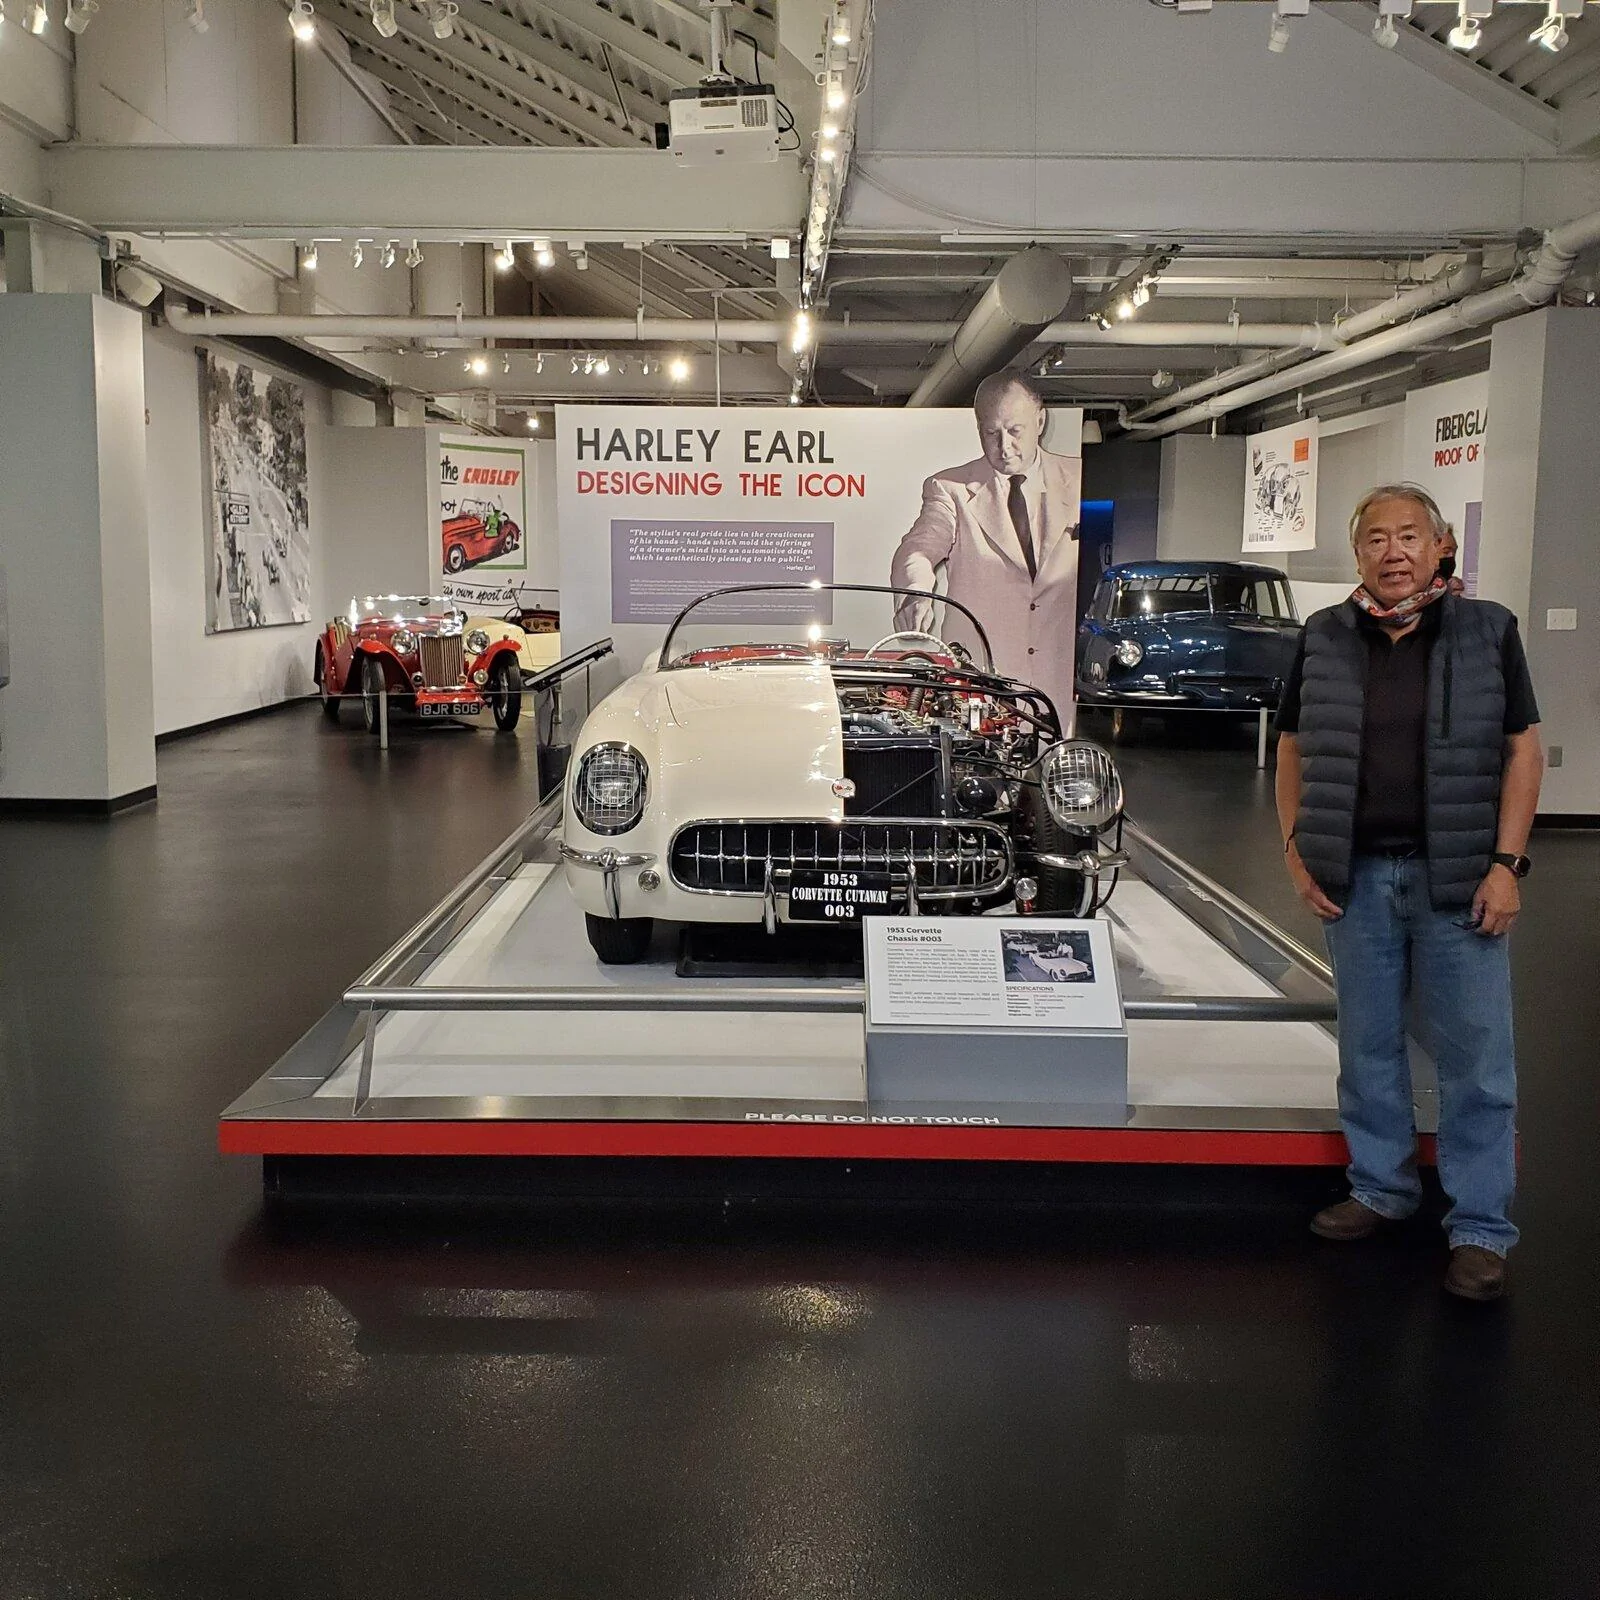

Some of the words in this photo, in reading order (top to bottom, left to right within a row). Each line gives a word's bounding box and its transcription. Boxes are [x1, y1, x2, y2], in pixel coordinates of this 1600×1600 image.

[576, 427, 721, 462] HARLEY
[743, 430, 835, 464] EARL
[1434, 446, 1463, 468] PROOF
[1466, 443, 1480, 462] OF
[440, 455, 459, 481] the
[462, 467, 520, 486] CROSLEY
[576, 471, 723, 496] DESIGNING
[738, 473, 783, 497] THE
[798, 473, 866, 497] ICON
[649, 529, 681, 538] stylist's
[700, 530, 723, 539] pride
[629, 538, 639, 547] of
[686, 538, 711, 546] hands
[775, 539, 812, 548] offerings
[629, 546, 639, 554] of
[646, 546, 686, 554] dreamer's
[741, 547, 786, 555] automotive
[787, 548, 814, 556] design
[664, 554, 717, 563] aesthetically
[717, 555, 752, 563] pleasing
[455, 587, 474, 599] own
[475, 588, 502, 606] sport
[423, 704, 449, 715] BJR
[452, 703, 479, 715] 606
[823, 873, 858, 886] 1953
[791, 887, 843, 902] CORVETTE
[845, 889, 888, 904] CUTAWAY
[824, 904, 855, 918] 003
[745, 1112, 827, 1122] PLEASE
[832, 1115, 866, 1123] DO
[871, 1116, 918, 1124] NOT
[921, 1116, 1001, 1124] TOUCH
